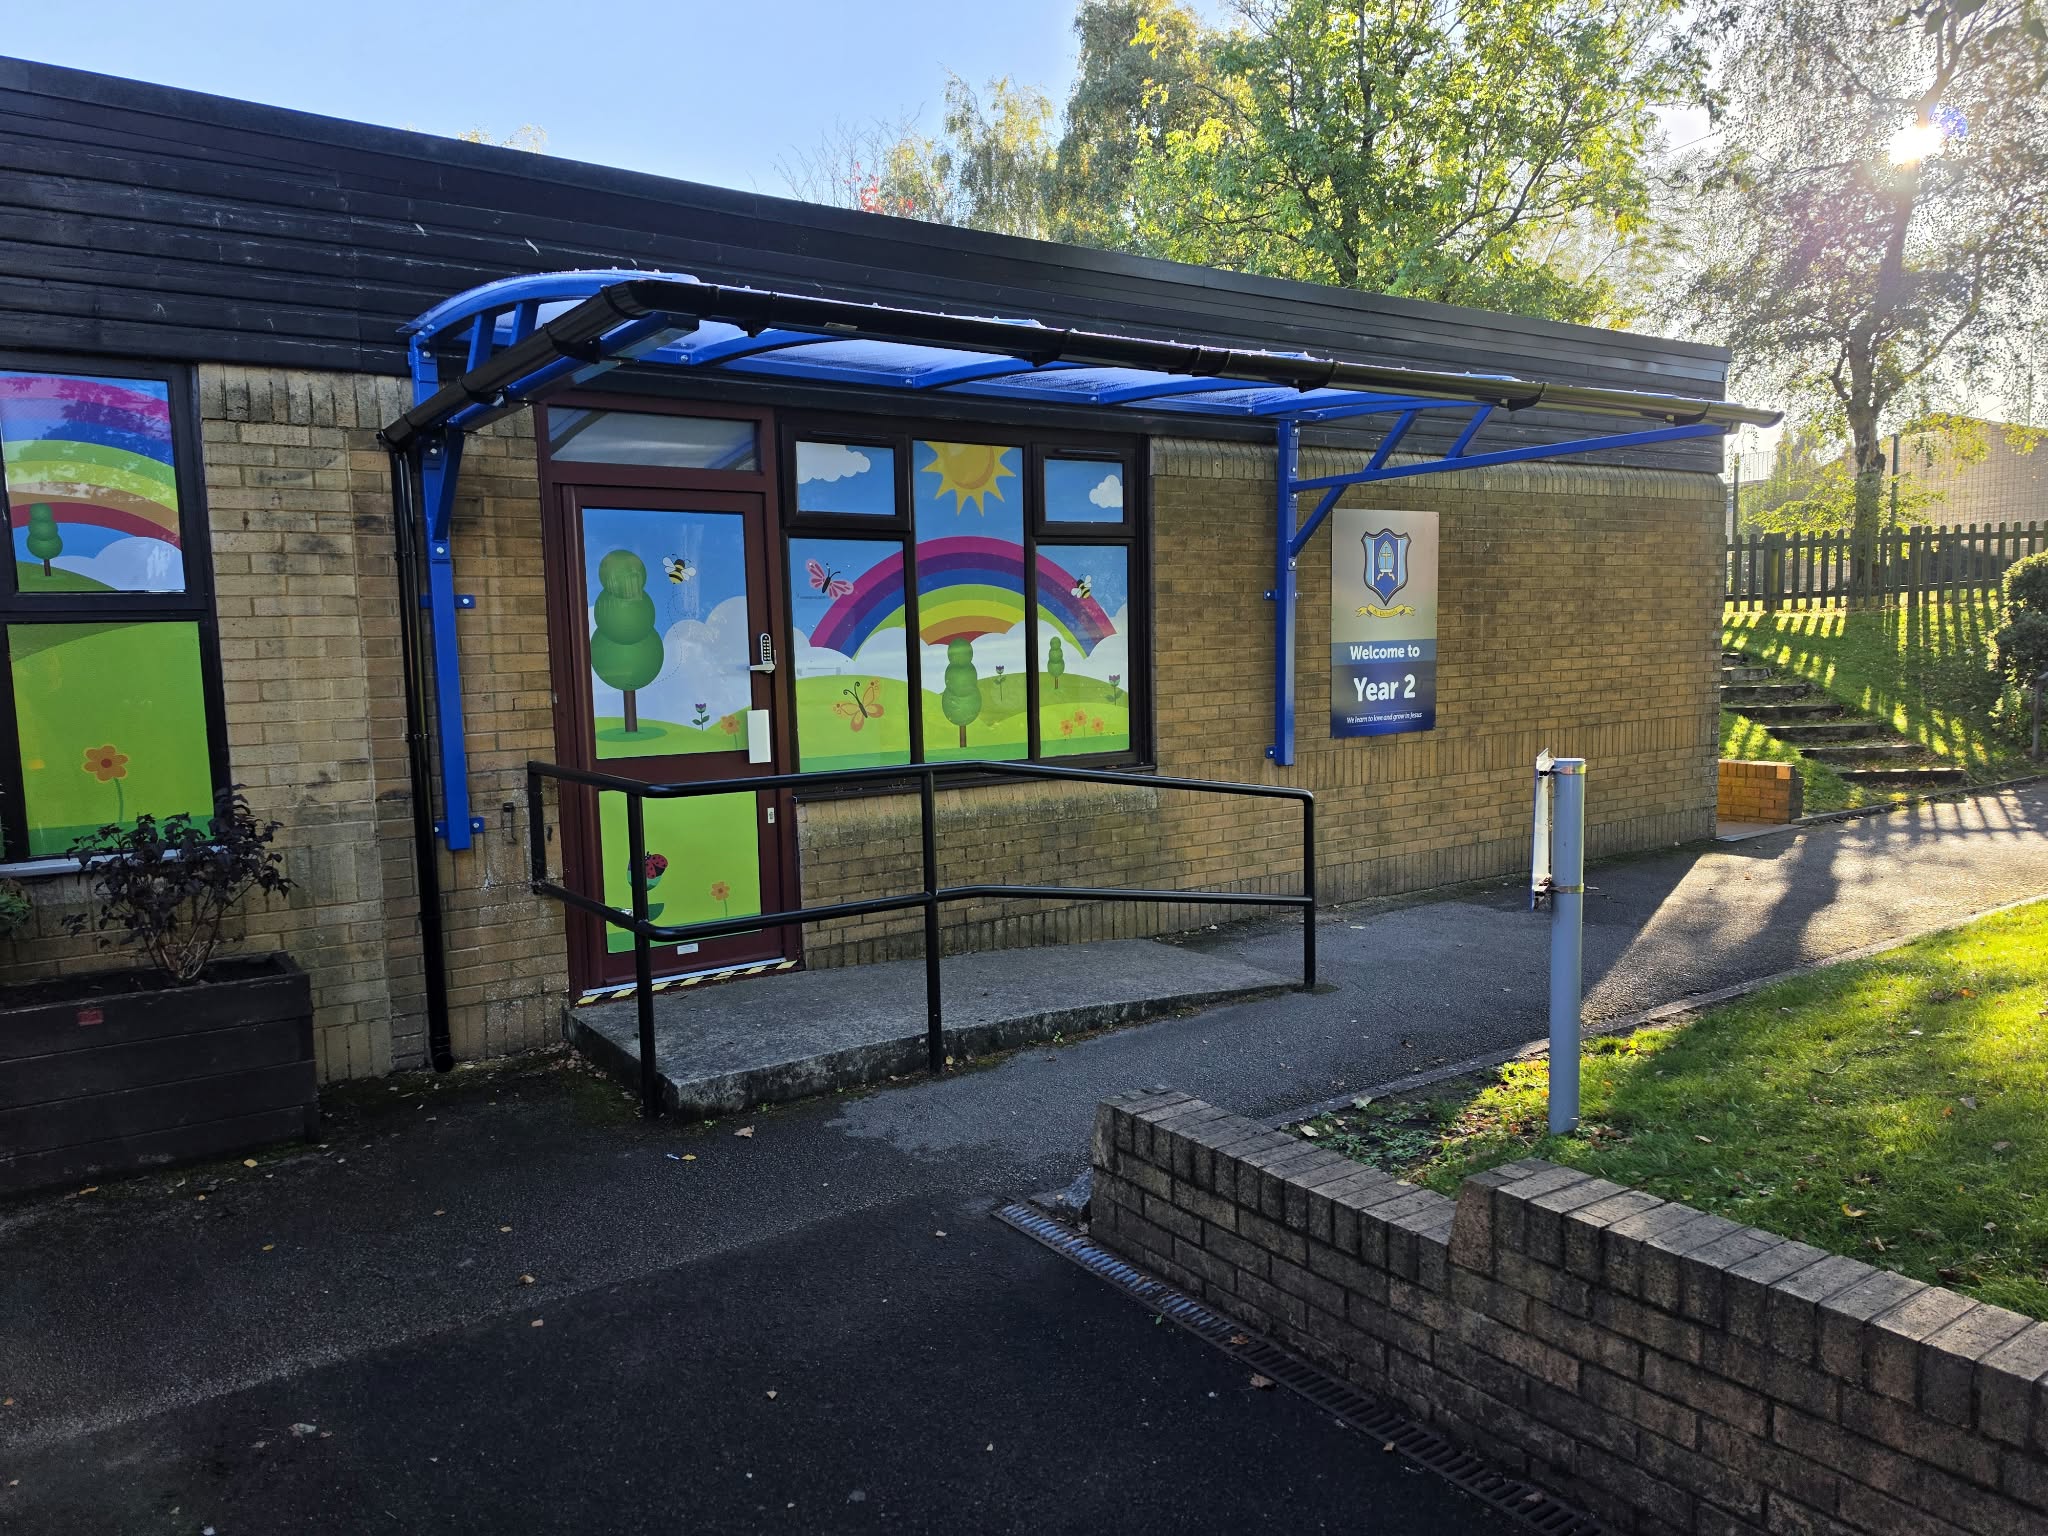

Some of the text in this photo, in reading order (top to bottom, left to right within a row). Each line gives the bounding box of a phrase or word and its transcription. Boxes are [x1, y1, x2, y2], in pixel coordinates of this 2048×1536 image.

[1350, 644, 1420, 660] Welcome to
[1353, 674, 1416, 702] Year 2
[1383, 713, 1392, 721] and
[1409, 711, 1422, 719] Jesus
